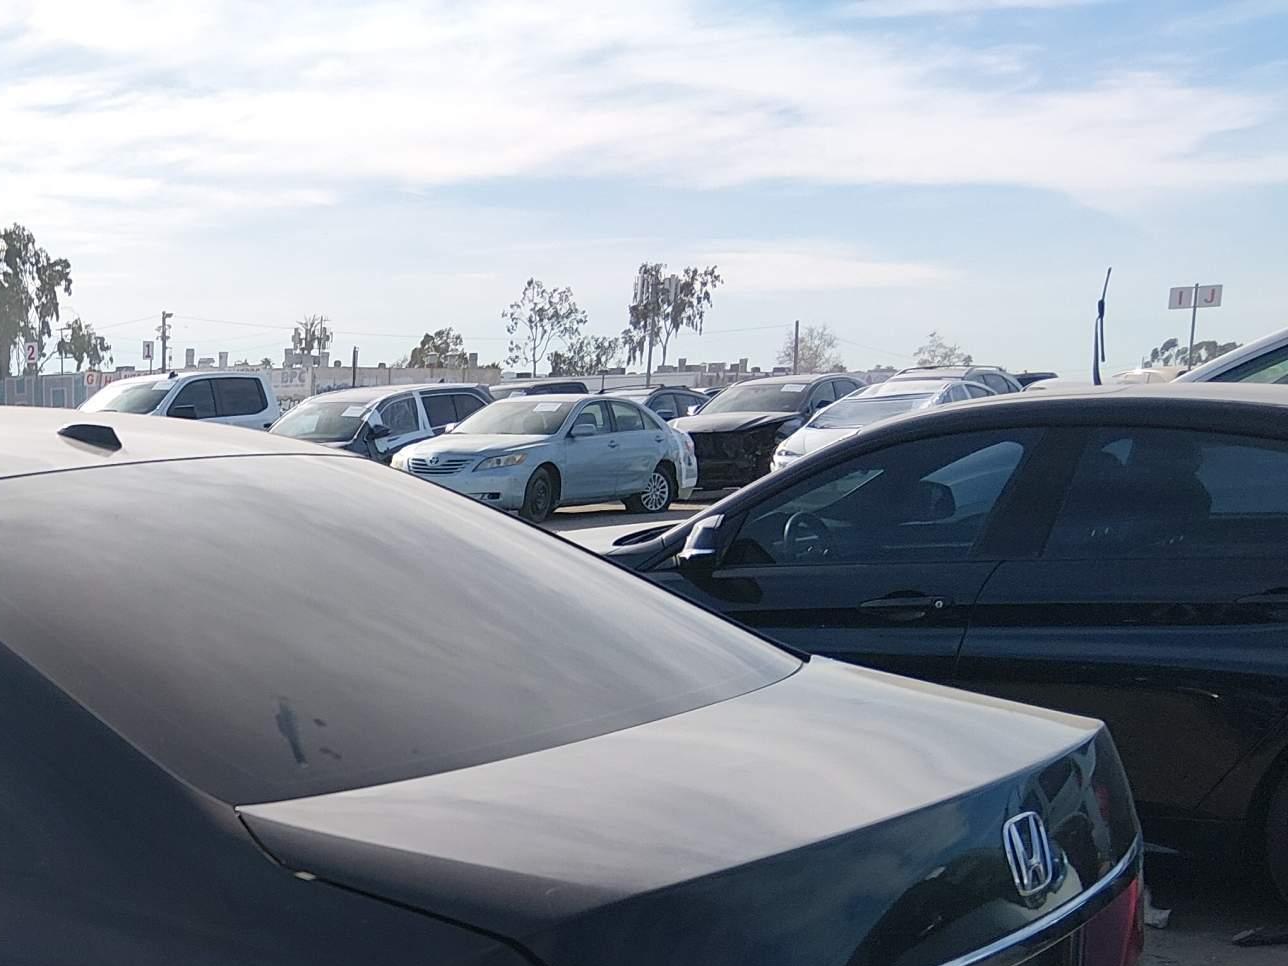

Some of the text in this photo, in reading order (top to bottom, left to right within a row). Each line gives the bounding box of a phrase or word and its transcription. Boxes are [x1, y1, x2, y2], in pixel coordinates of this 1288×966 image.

[1203, 288, 1216, 304] J
[27, 344, 36, 361] 2
[145, 343, 152, 358] 1
[86, 373, 95, 385] G
